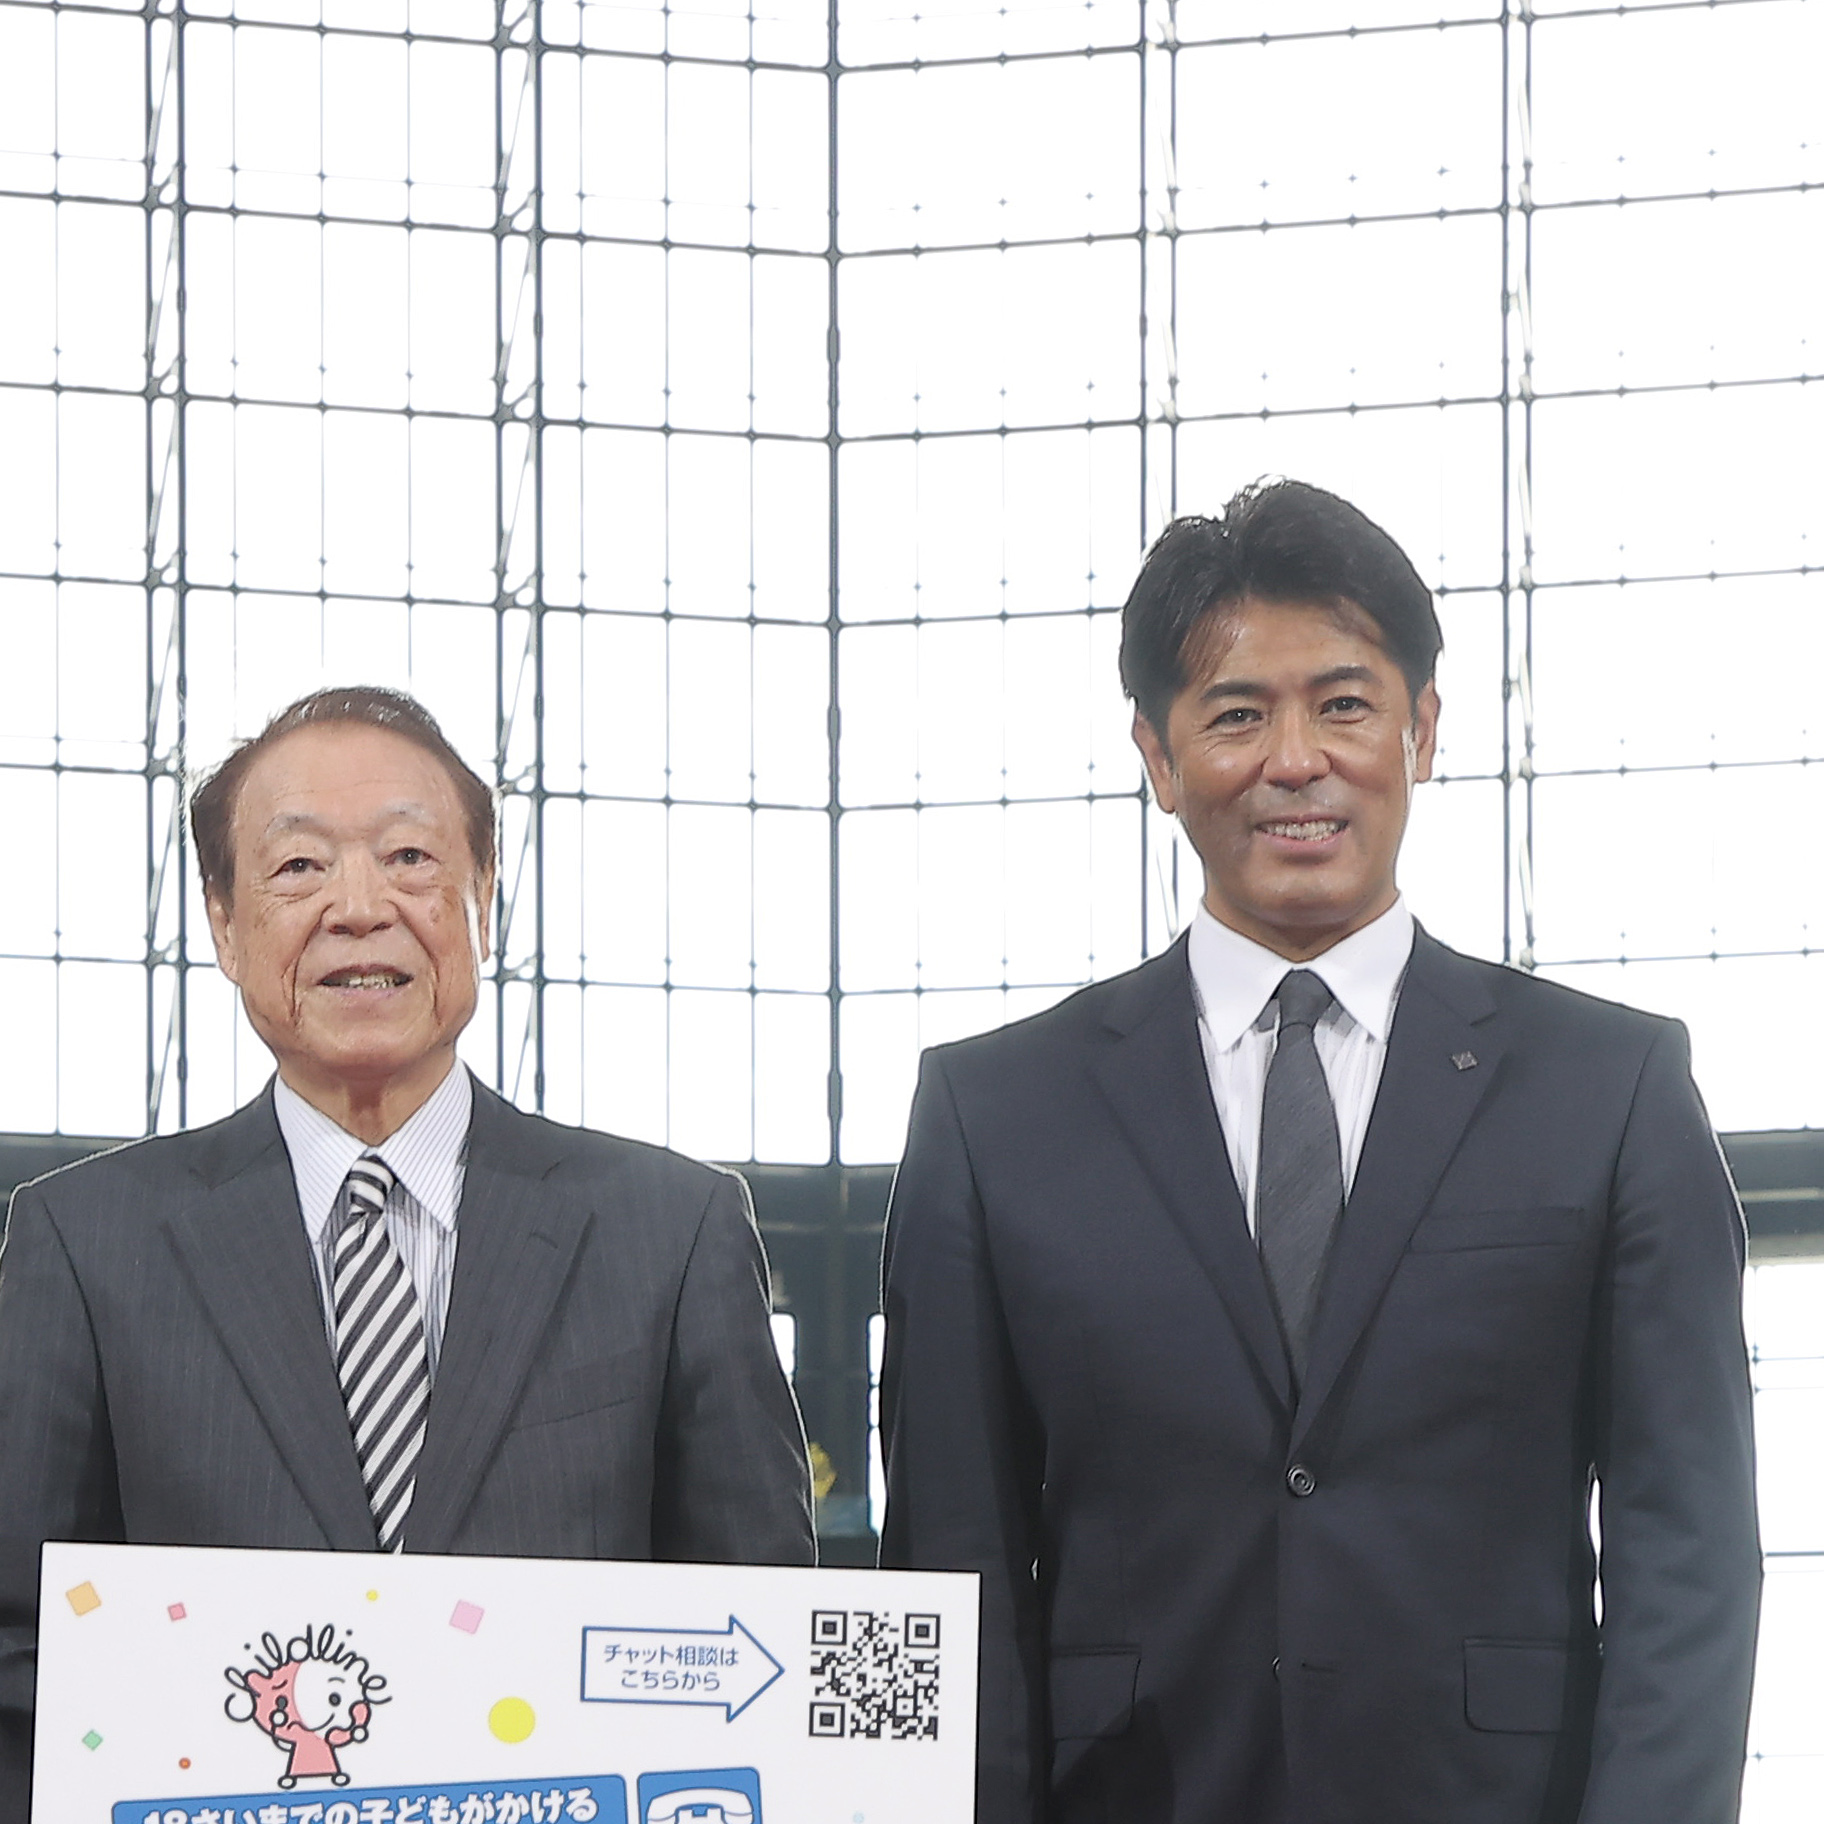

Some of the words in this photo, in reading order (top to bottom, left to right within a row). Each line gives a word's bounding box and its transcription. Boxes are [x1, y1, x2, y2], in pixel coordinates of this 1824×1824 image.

[604, 1644, 739, 1666] チャット相談は
[621, 1669, 720, 1691] こちらから
